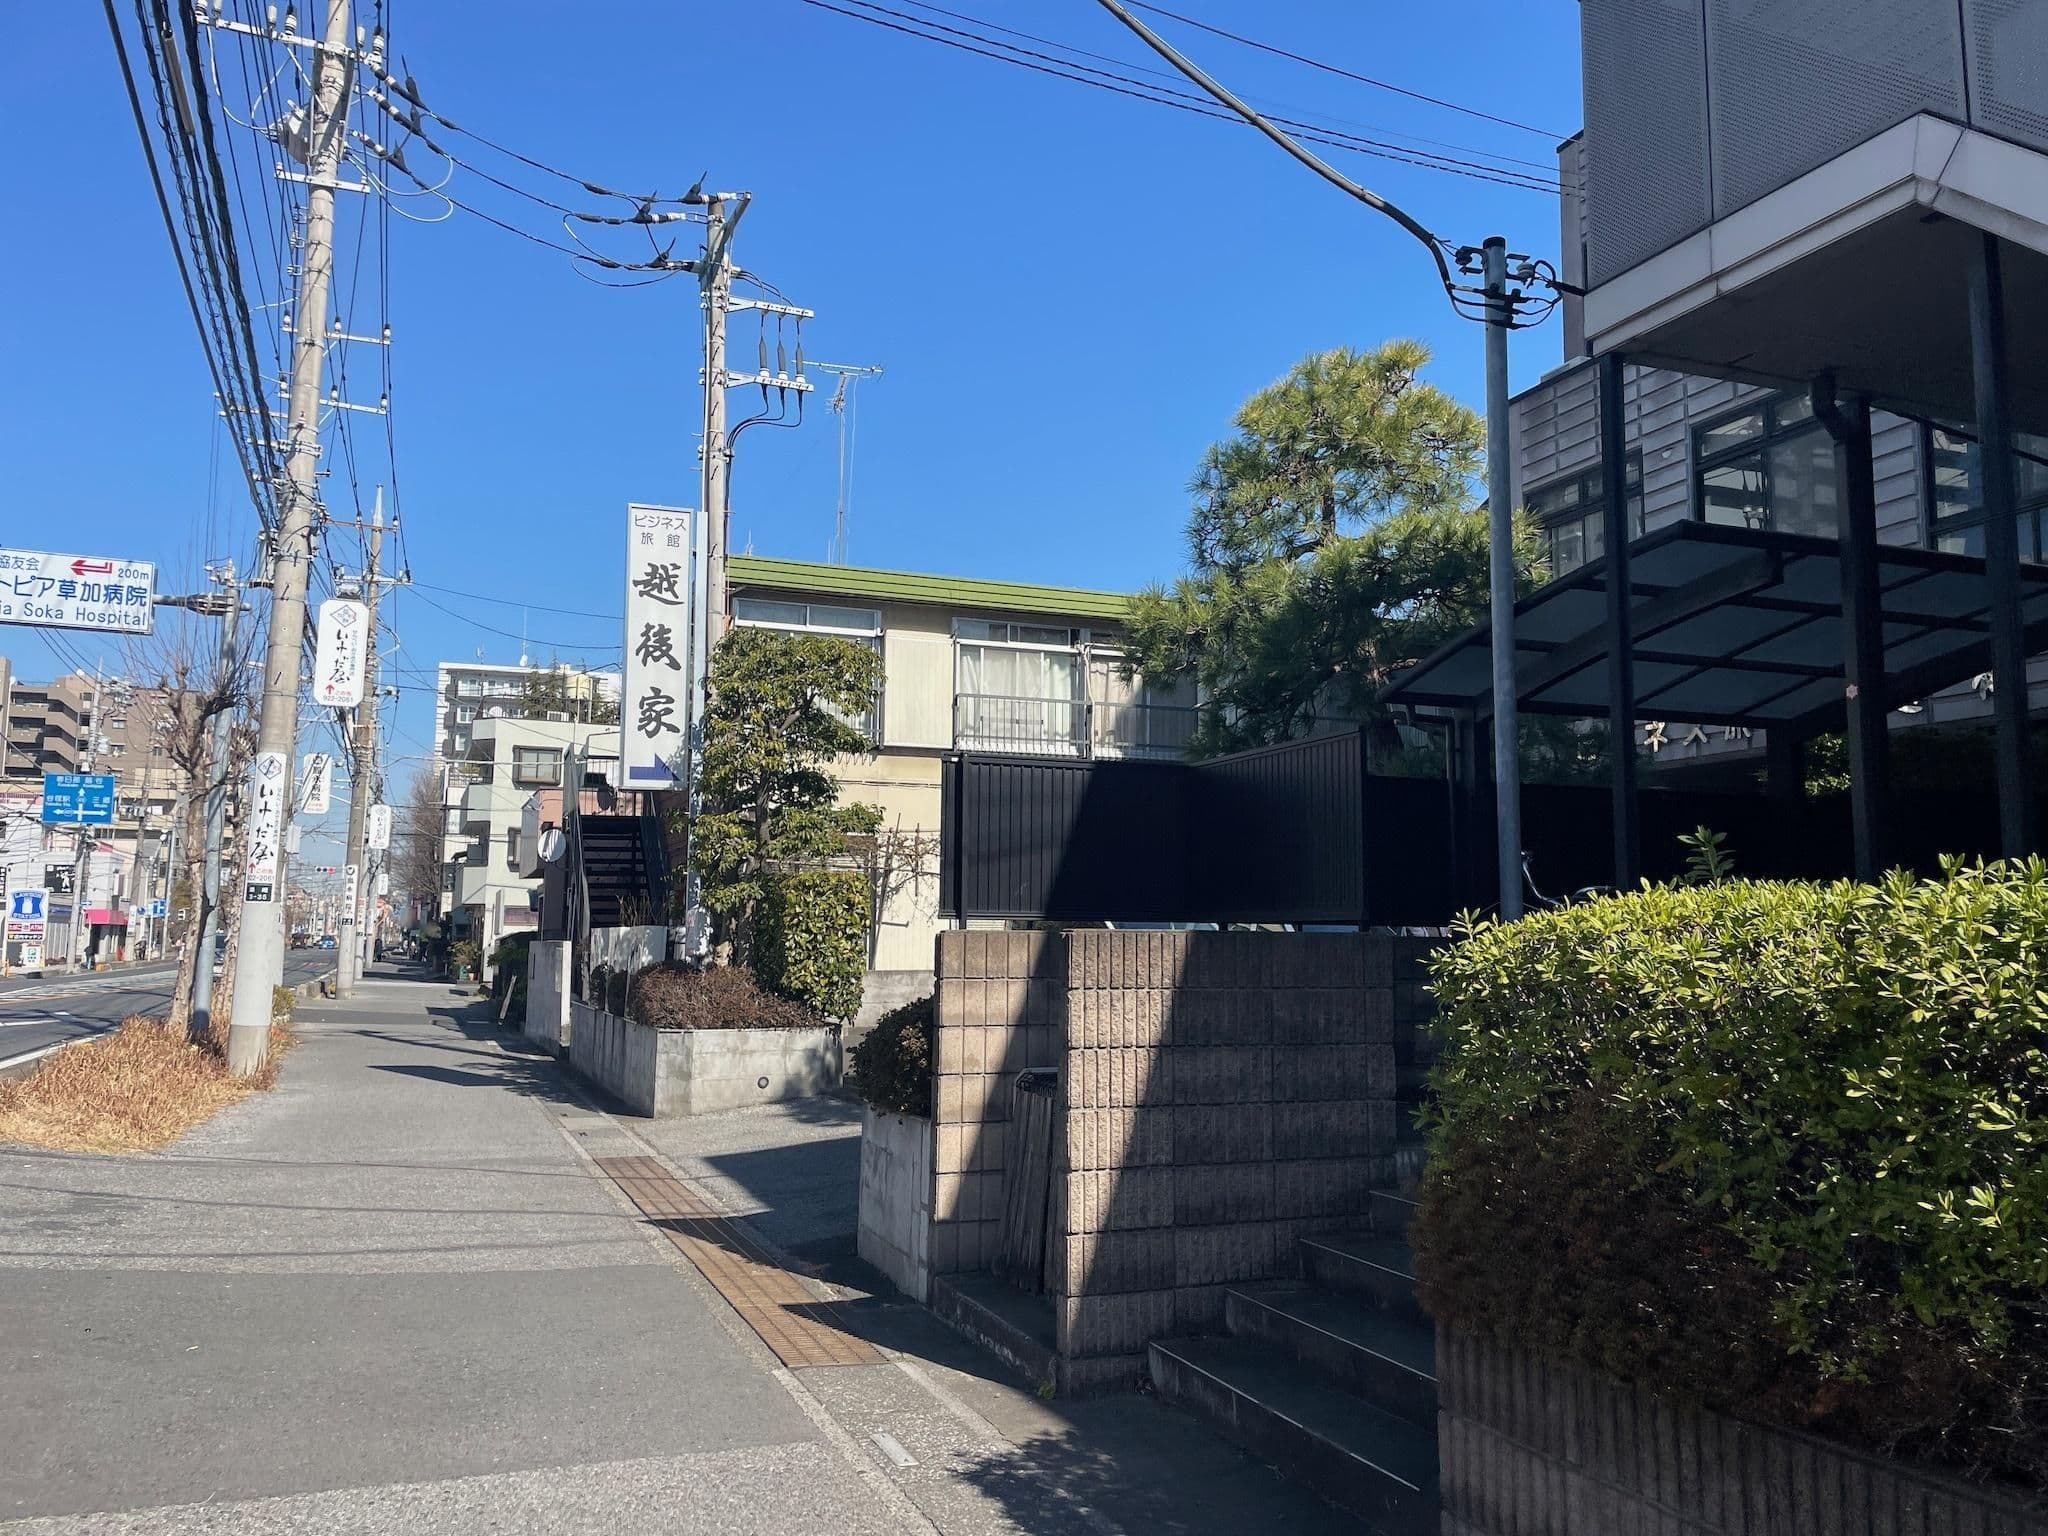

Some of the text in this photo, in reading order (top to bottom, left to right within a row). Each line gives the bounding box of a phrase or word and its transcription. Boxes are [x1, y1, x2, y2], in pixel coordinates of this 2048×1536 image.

[635, 514, 687, 531] ビジネス
[641, 532, 680, 548] 旅館
[118, 568, 149, 579] 200m
[24, 602, 64, 619] Soka
[76, 606, 146, 626] Hospital
[633, 562, 685, 738] 越後家
